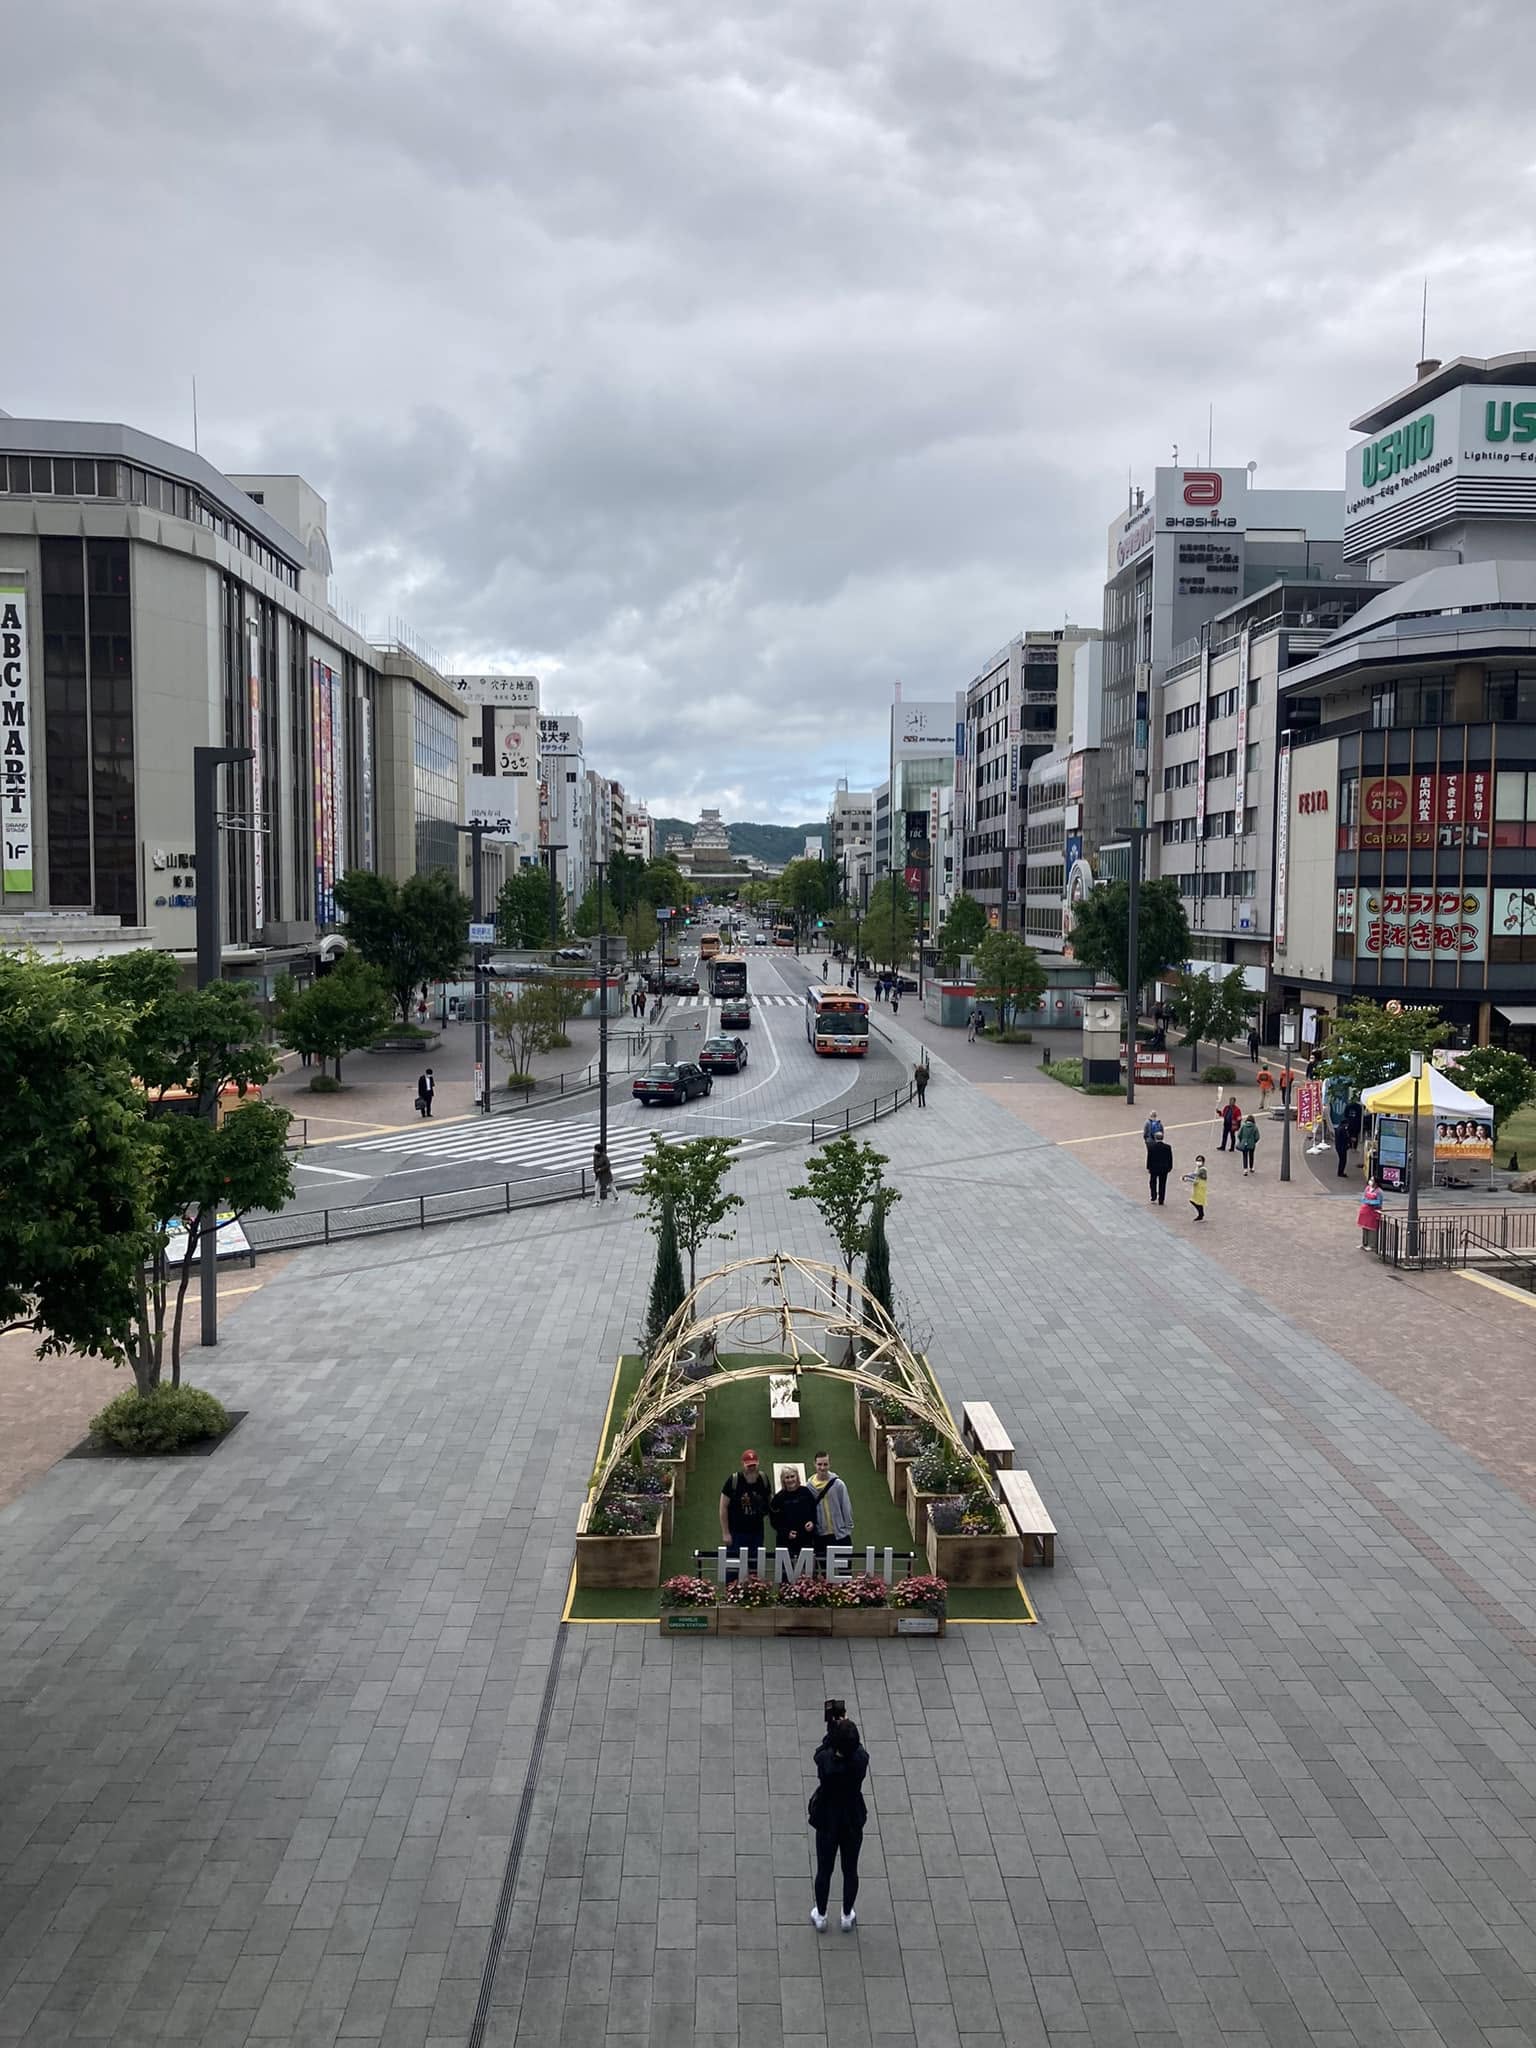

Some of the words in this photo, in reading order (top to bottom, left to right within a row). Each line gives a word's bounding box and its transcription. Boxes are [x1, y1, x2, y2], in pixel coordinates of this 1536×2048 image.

[1363, 414, 1434, 488] USHIO
[1400, 456, 1453, 487] Technologies
[491, 680, 534, 691] 穴子と地酒
[1298, 789, 1328, 814] FESTA
[1371, 798, 1404, 810] ガスト
[1419, 776, 1431, 822] 店内飲食
[1446, 775, 1457, 820] できます
[1473, 774, 1484, 820] お持ち帰り
[6, 841, 29, 859] 1F
[1439, 825, 1489, 846] ガスト
[1365, 919, 1478, 953] まねきねこ
